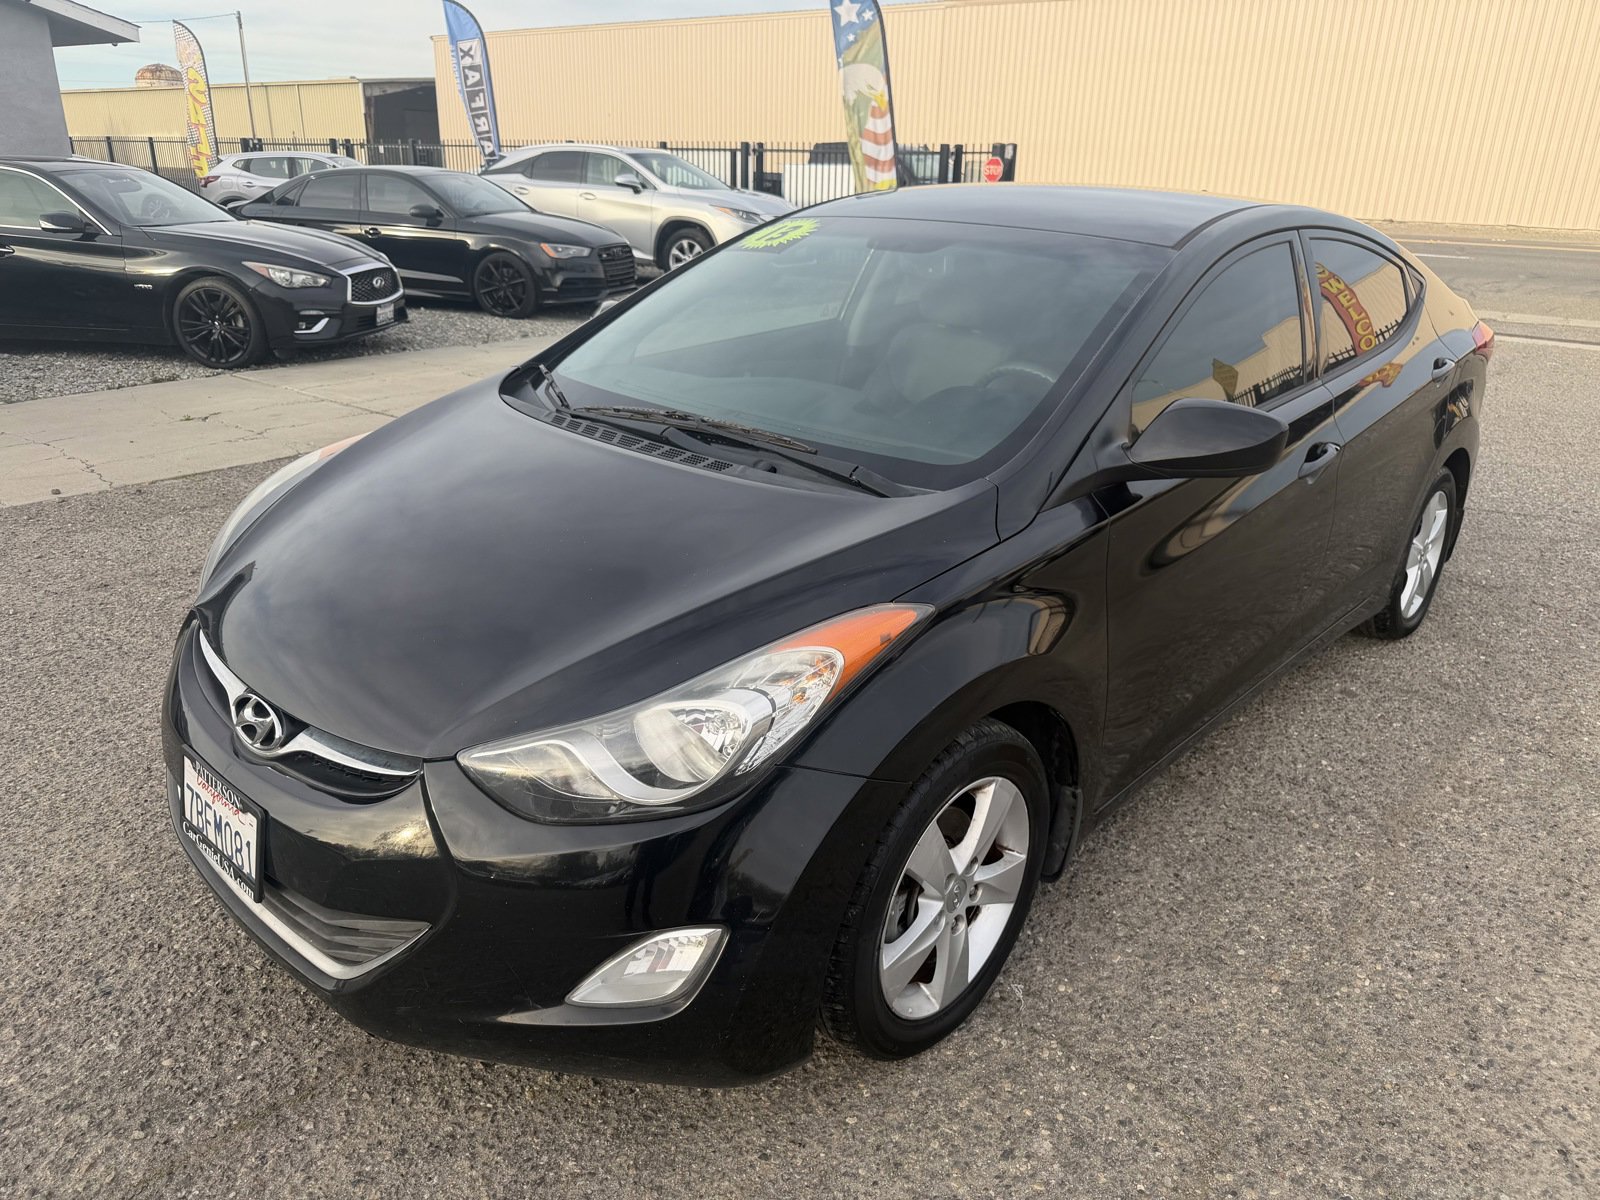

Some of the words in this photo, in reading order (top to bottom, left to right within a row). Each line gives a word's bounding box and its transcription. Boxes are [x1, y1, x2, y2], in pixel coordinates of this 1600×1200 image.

[984, 164, 1003, 177] STOP
[196, 760, 242, 808] PATTERSON
[182, 821, 255, 900] CarGenieUSA.com
[186, 783, 256, 880] 7BFM081
